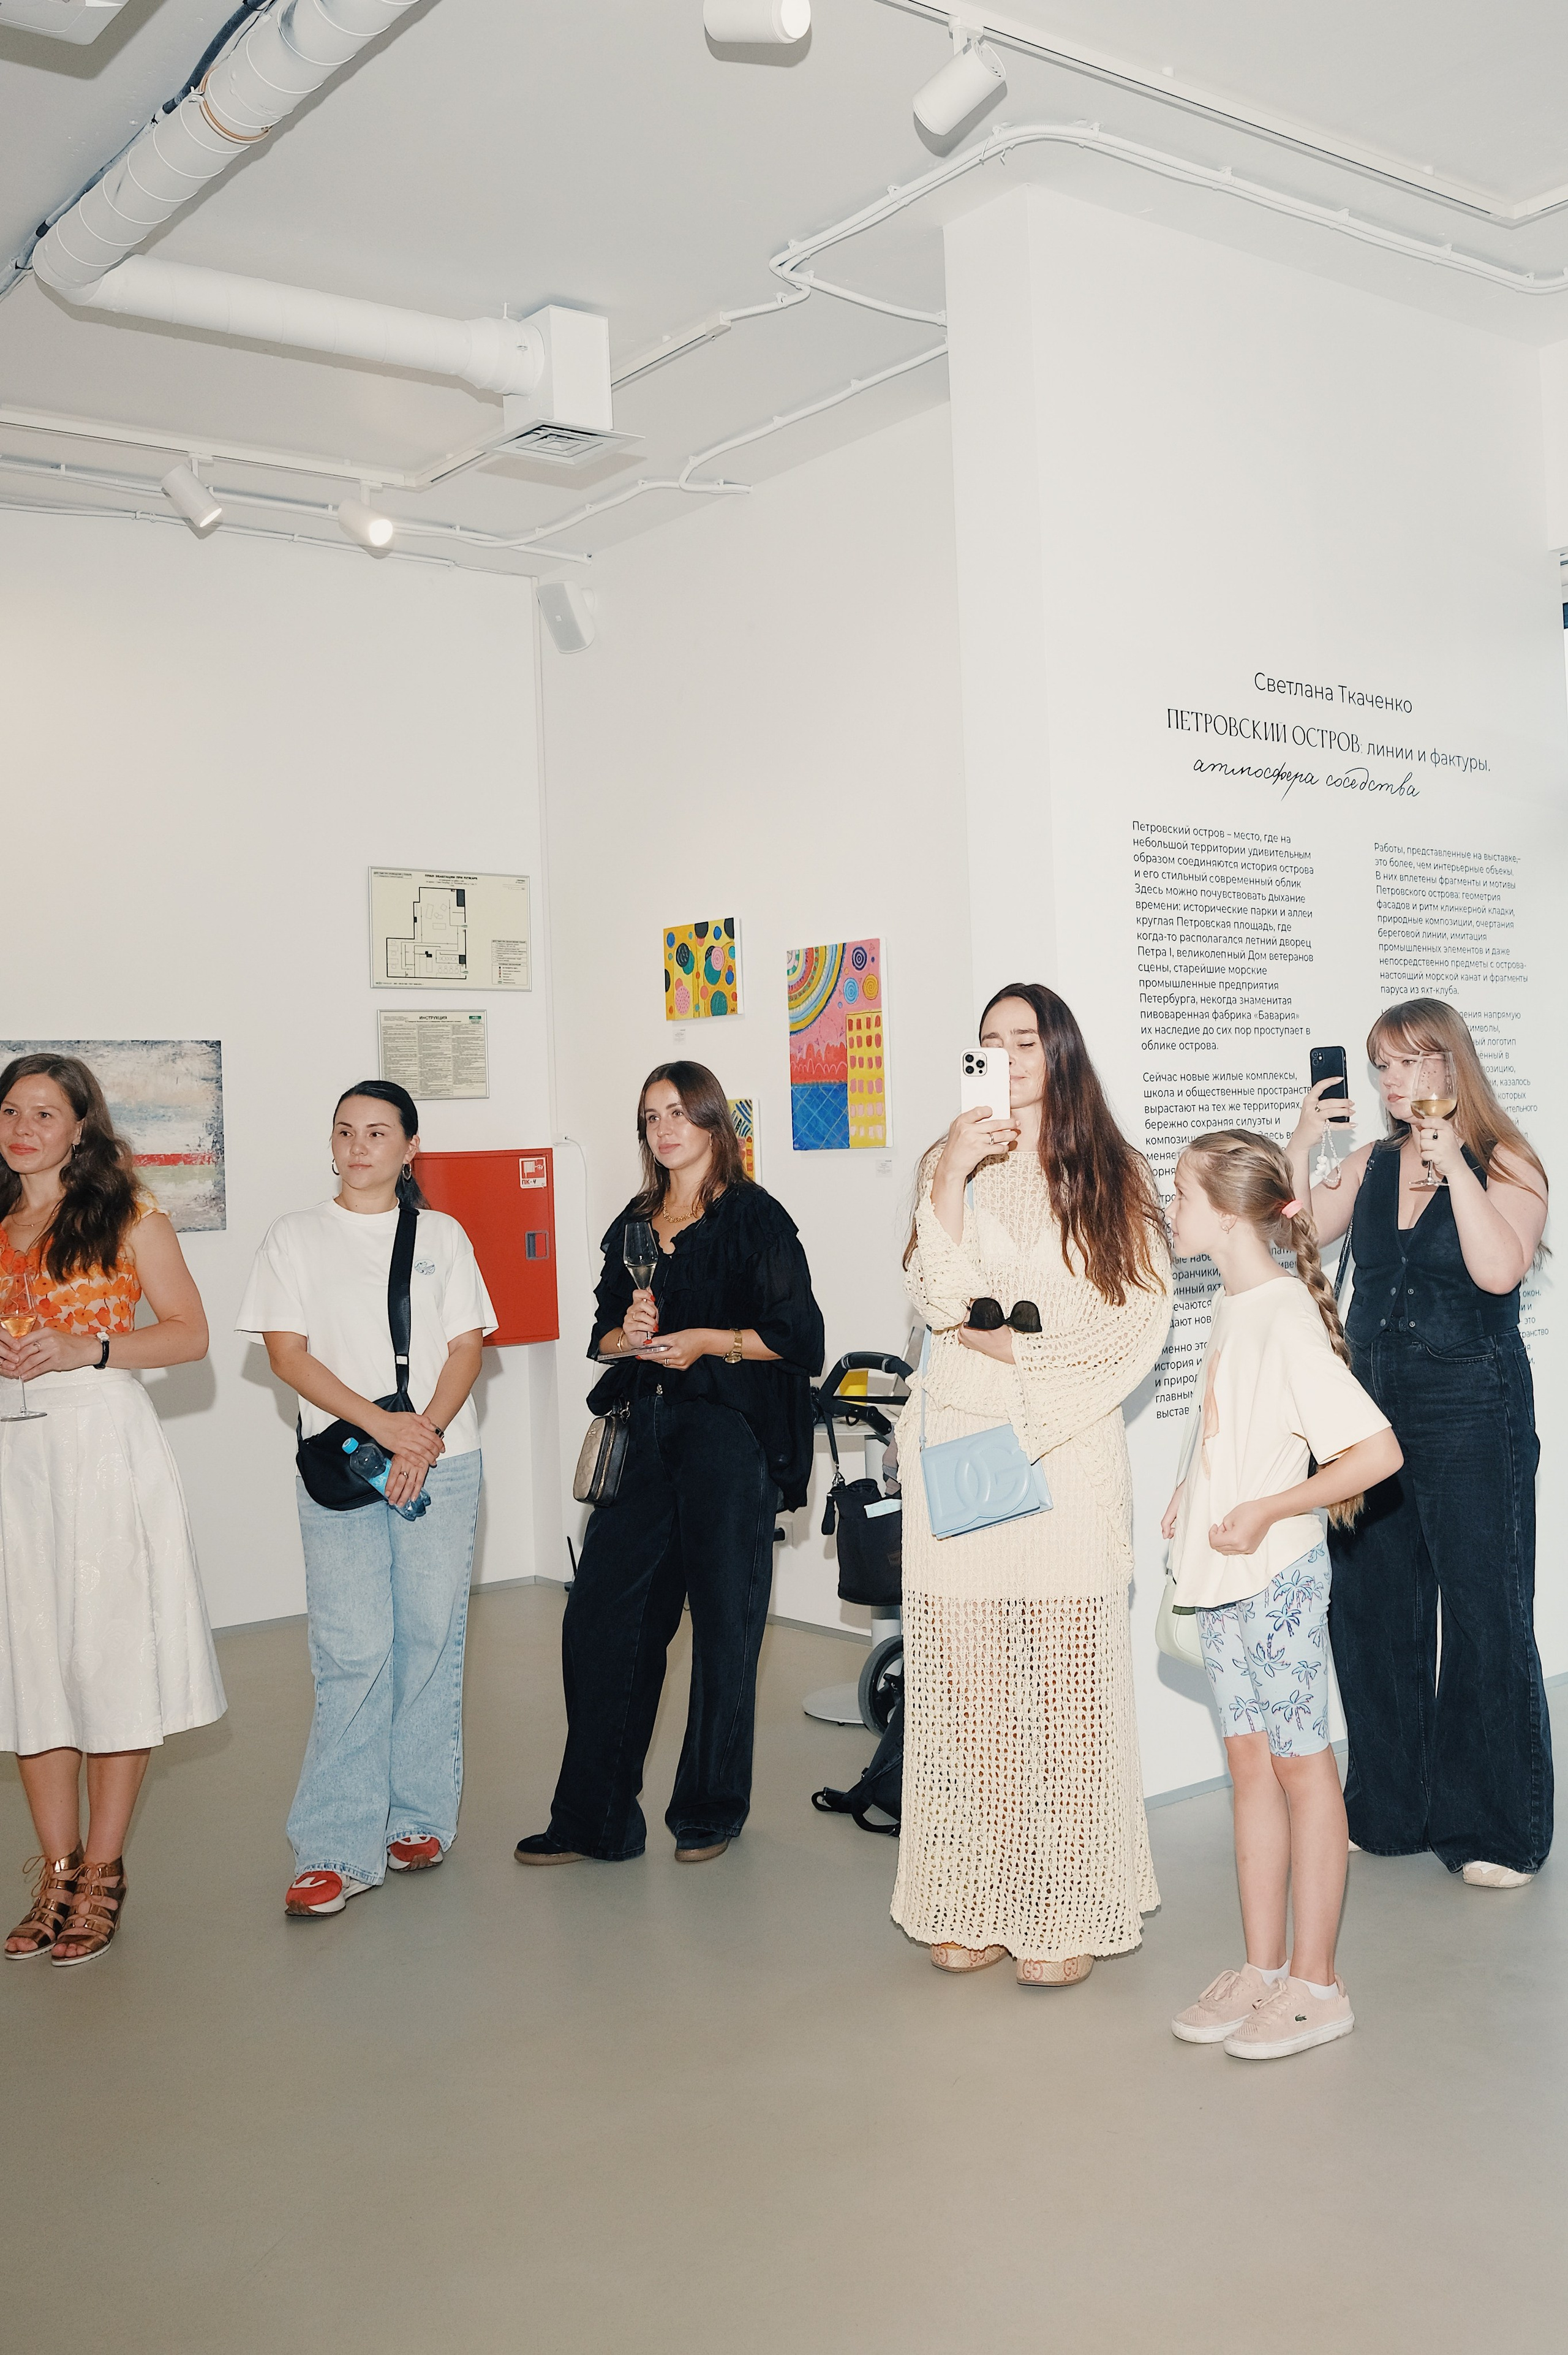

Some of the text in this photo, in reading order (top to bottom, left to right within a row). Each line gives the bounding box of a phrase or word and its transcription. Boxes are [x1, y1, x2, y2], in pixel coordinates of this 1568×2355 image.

[1254, 673, 1412, 713] Светлана Ткаченко
[1168, 709, 1286, 743] ПЕТРОВСКИЙ
[1367, 743, 1412, 760] линии
[1418, 750, 1425, 762] и
[1430, 748, 1490, 773] фактуры.
[1193, 759, 1420, 801] атмосфера соседства
[1133, 821, 1190, 834] Петровский
[1193, 828, 1224, 839] остров
[1234, 832, 1261, 842] место,
[1264, 834, 1278, 843] где
[1133, 837, 1311, 859] небольшой территории удивительным
[1374, 842, 1405, 855] Работы,
[1407, 847, 1471, 859] представленные
[1134, 852, 1313, 875] образом соединяются история острова
[1390, 857, 1415, 869] более,
[1434, 863, 1483, 874] интерьерные
[1161, 872, 1207, 882] стильный
[1275, 877, 1301, 888] облик
[1376, 871, 1381, 880] В
[1400, 875, 1436, 883] вплетены
[1439, 875, 1480, 886] фрагменты
[1135, 883, 1305, 903] Здесь можно почувствовать дыхание
[1376, 885, 1501, 902] Петровского острова: геометрия
[1136, 901, 1180, 911] времени:
[1183, 904, 1248, 914] исторические
[1251, 908, 1277, 917] парки
[1377, 899, 1410, 910] фасадов
[1419, 904, 1438, 912] ритм
[1441, 905, 1486, 915] клинкерной
[1488, 907, 1515, 917] кладки,
[1137, 917, 1291, 932] круглая Петровская площадь, где
[1378, 915, 1513, 929] природные композиции, очертания
[1137, 932, 1311, 949] когда-то располагался летний дворец
[1378, 928, 1487, 942] береговой линии, имитация
[1138, 946, 1166, 959] Петра
[1177, 950, 1245, 959] великолепный
[1248, 950, 1266, 961] Дом
[1269, 953, 1313, 962] ветеранов
[1379, 944, 1441, 953] промышленных
[1138, 964, 1267, 977] сцены, старейшие морские
[1379, 958, 1449, 967] непосредственно
[1451, 960, 1488, 969] предметы
[1381, 971, 1423, 981] настоящий
[1426, 973, 1458, 982] морской
[1490, 973, 1528, 983] фрагменты
[1139, 980, 1278, 992] промышленные предприятия
[1381, 986, 1408, 996] паруса
[1421, 985, 1459, 996] яхт-клуба.
[1140, 993, 1197, 1006] Петербурга,
[1200, 997, 1237, 1005] некогда
[1140, 1009, 1299, 1022] пивоваренная фабрика «Бавария»
[1155, 1027, 1200, 1035] наследие
[1203, 1027, 1214, 1036] до
[1235, 1027, 1251, 1037] пор
[1254, 1027, 1303, 1037] проступает
[1466, 1024, 1501, 1034] имволы,
[1142, 1040, 1218, 1052] облике острова.
[1143, 1072, 1177, 1082] Сейчас
[1186, 1086, 1254, 1097] общественные
[1257, 1086, 1311, 1097] пространств
[1145, 1105, 1196, 1116] вырастают
[1145, 1119, 1188, 1131] бережно
[1191, 1119, 1233, 1129] сохраняя
[1236, 1117, 1272, 1128] силуэты
[1172, 1268, 1221, 1282] оранчики,
[1173, 1299, 1212, 1312] ечаются
[1194, 1315, 1212, 1325] нов
[1161, 1344, 1192, 1355] менно
[1154, 1359, 1194, 1372] история
[1155, 1379, 1161, 1388] и
